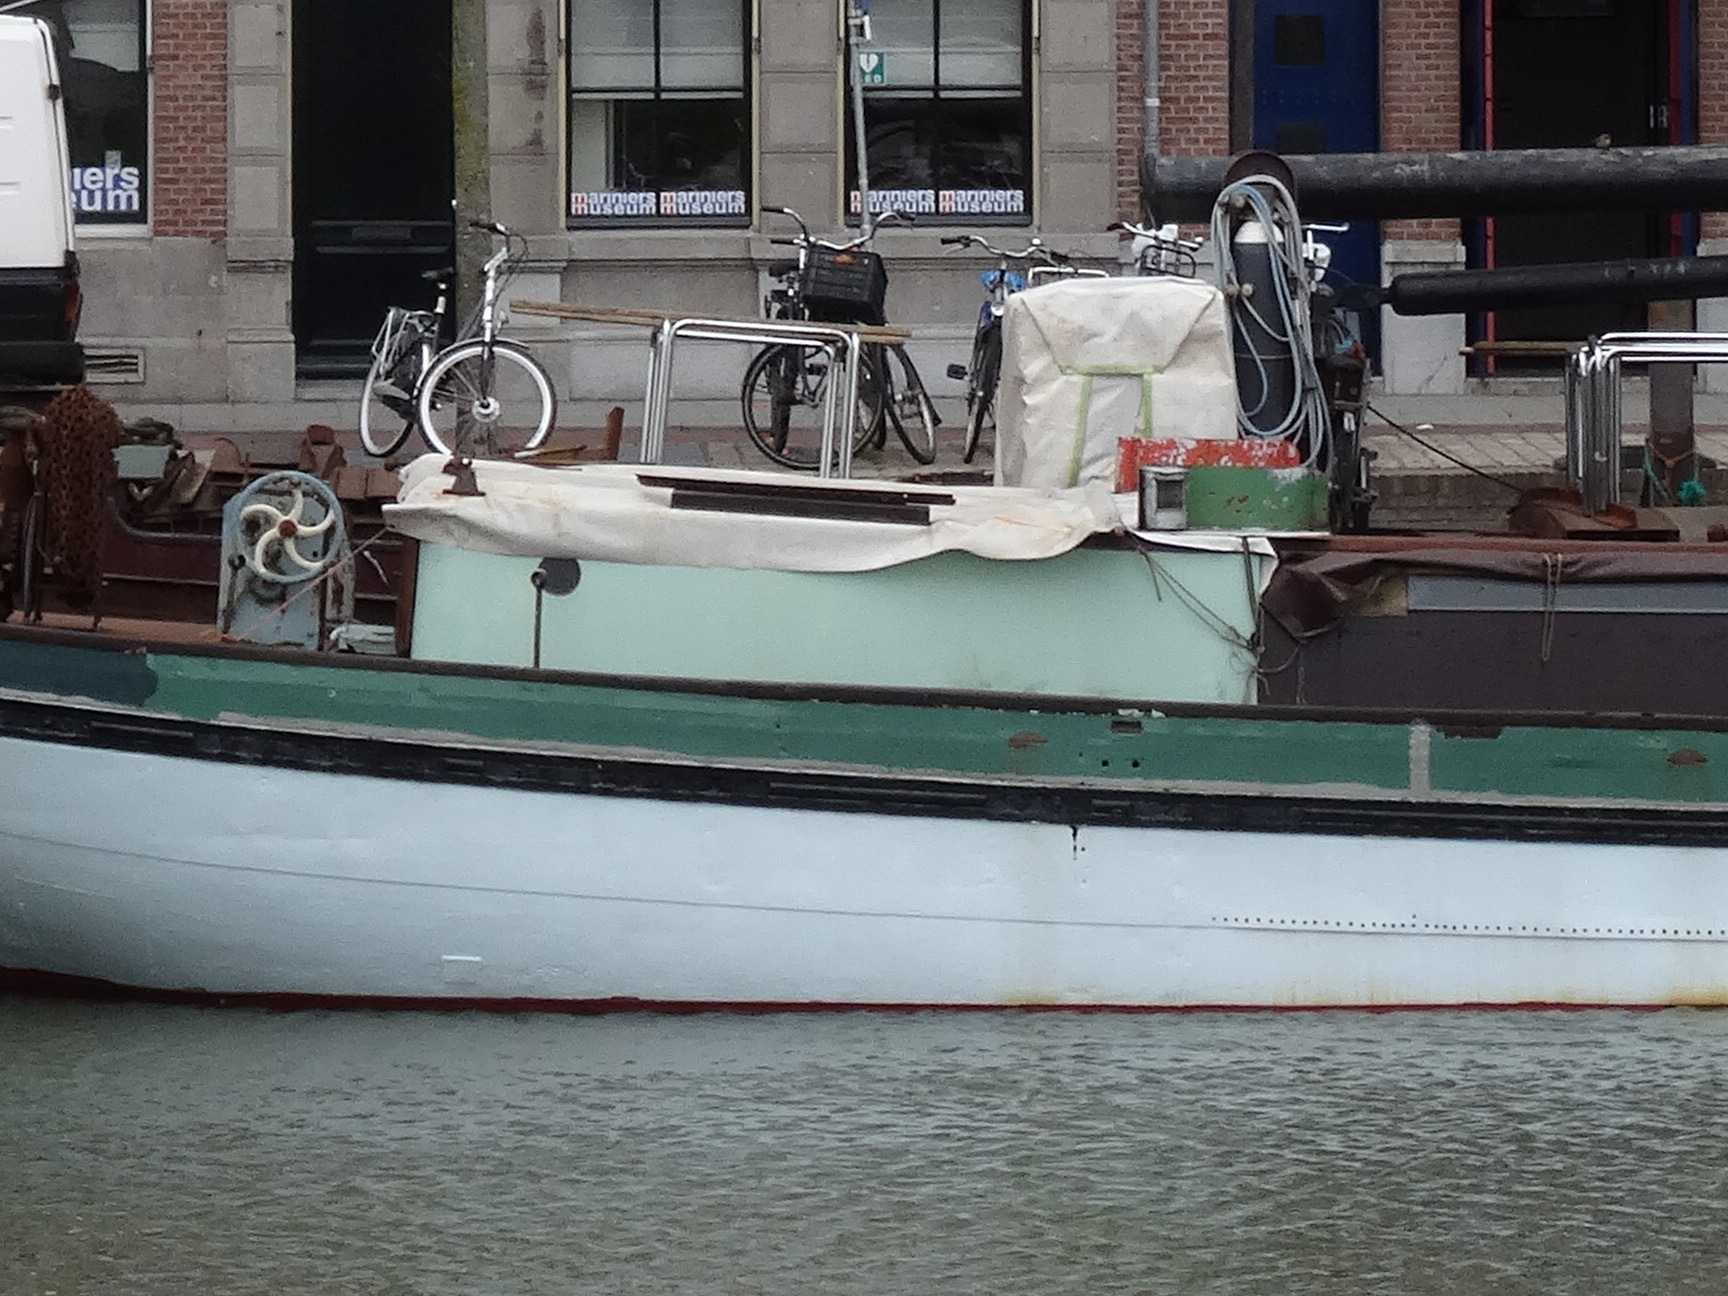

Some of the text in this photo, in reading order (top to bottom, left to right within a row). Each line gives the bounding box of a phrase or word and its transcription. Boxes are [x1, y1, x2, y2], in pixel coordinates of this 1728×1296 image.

[70, 166, 140, 190] iers
[571, 191, 656, 205] mariniers
[660, 190, 745, 204] mariniers
[939, 189, 1024, 203] mariniers
[571, 203, 656, 215] museum
[660, 201, 745, 214] museum
[939, 200, 1024, 213] museum
